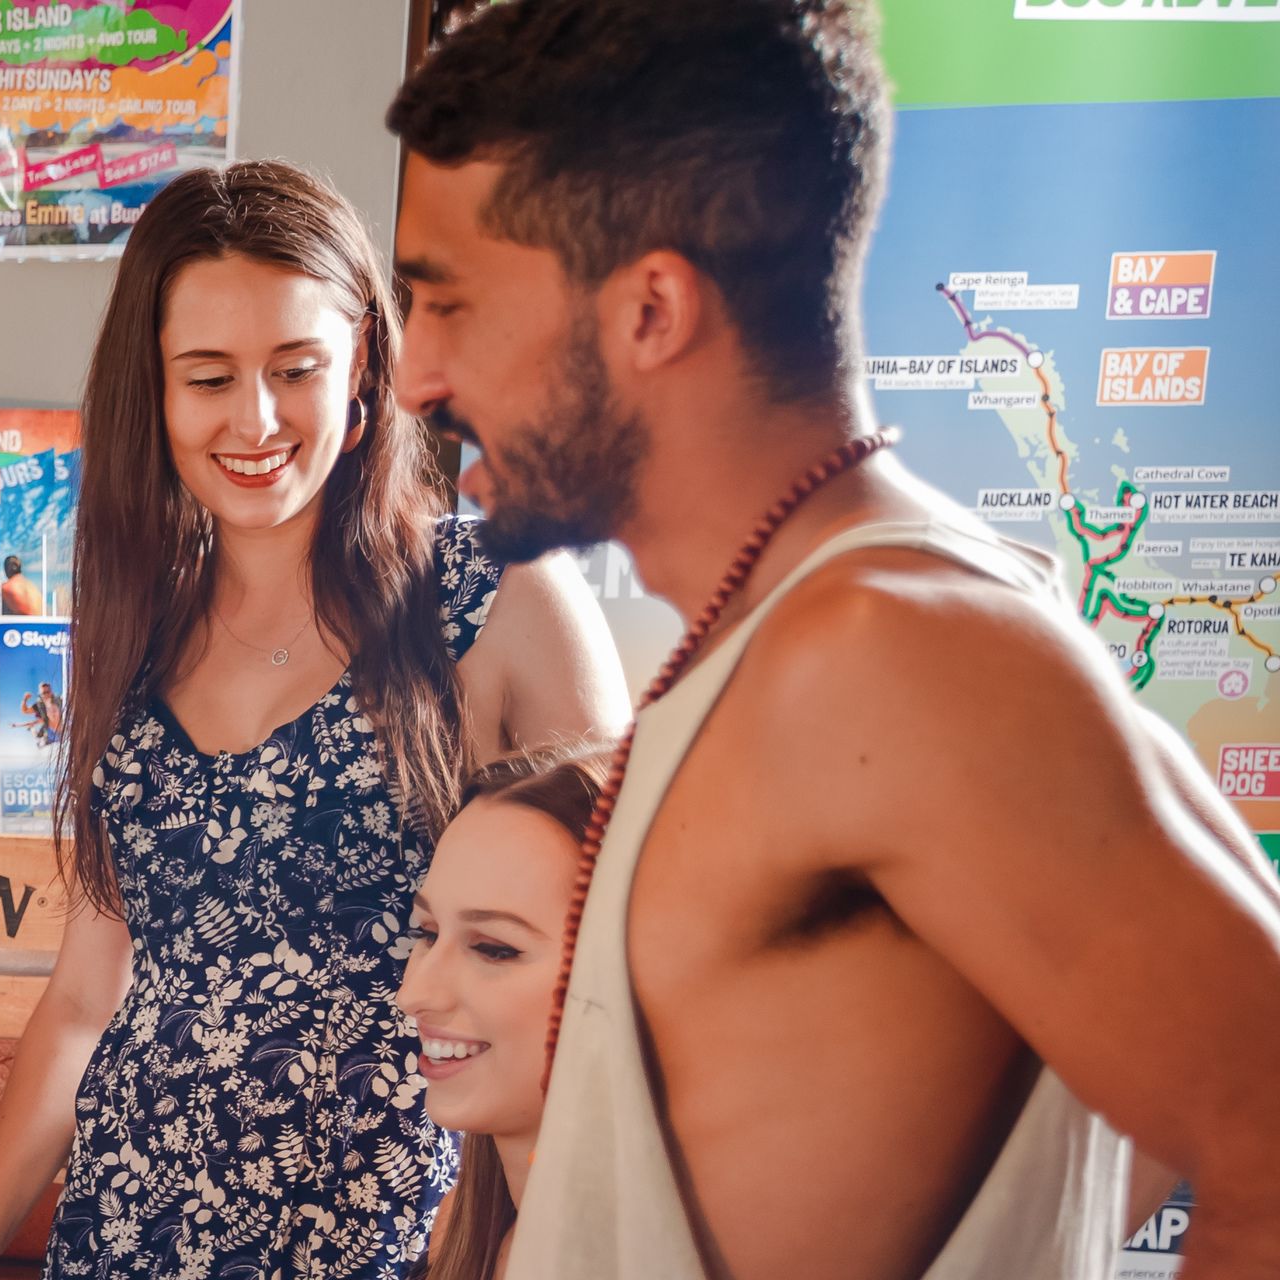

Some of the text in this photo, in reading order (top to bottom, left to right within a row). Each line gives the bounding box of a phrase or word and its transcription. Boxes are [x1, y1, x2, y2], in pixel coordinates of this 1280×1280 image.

[6, 4, 73, 31] ISLAND
[43, 34, 85, 51] NIGHTS
[128, 28, 157, 44] TOUR
[166, 99, 197, 116] TOUR
[26, 200, 85, 225] Emma
[89, 206, 109, 225] at
[1117, 256, 1166, 283] BAY
[952, 274, 1025, 289] Cape Reinga
[1113, 287, 1204, 315] & CAPE
[938, 359, 956, 374] OF
[959, 359, 1018, 374] ISLANDS
[1105, 352, 1184, 377] BAY OF
[1102, 375, 1201, 401] ISLANDS
[972, 394, 1037, 409] Whangarei
[1135, 467, 1228, 481] Cathedral Cove
[981, 492, 1052, 507] AUCKLAND
[1153, 493, 1279, 509] HOT WATER BEACH
[1088, 509, 1134, 521] Thames
[1136, 543, 1179, 553] Paeroa
[1229, 552, 1248, 567] TE
[1117, 580, 1173, 591] Hobbiton
[1181, 583, 1252, 593] Whakatane
[1167, 619, 1230, 634] ROTORUA
[1221, 773, 1266, 796] DOG
